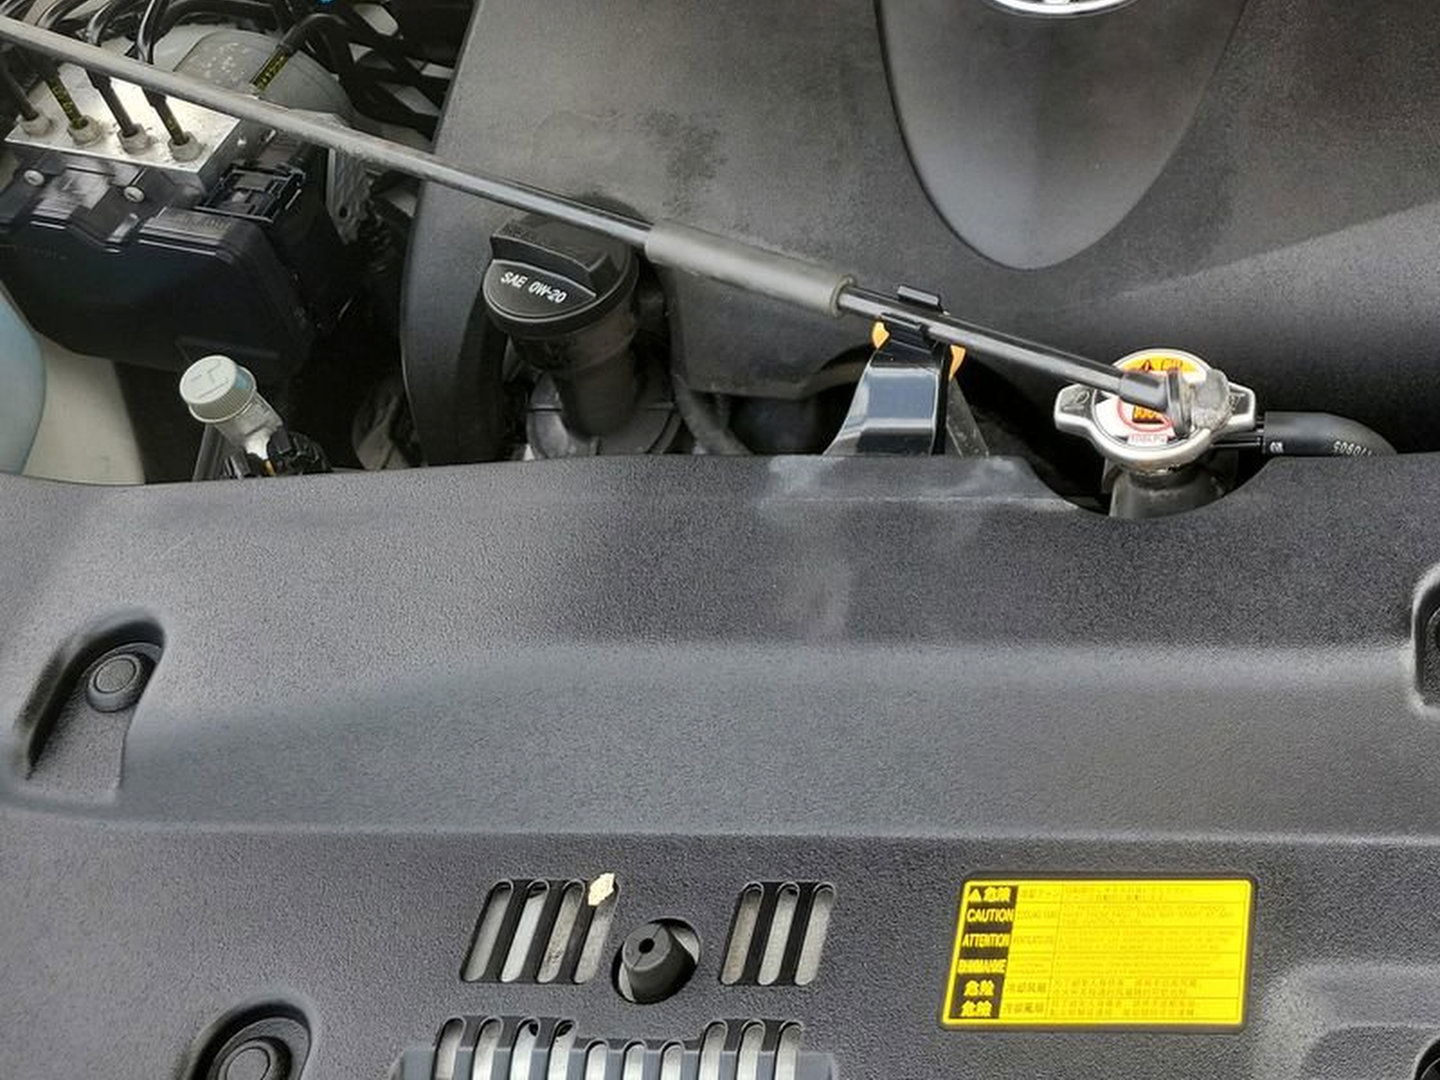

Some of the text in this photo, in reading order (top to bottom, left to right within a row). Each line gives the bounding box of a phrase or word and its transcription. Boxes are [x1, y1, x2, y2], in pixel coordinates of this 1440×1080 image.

[500, 271, 568, 304] SAE 0W-20
[967, 908, 1015, 923] CAUTION
[962, 933, 1010, 948] ATTENTION
